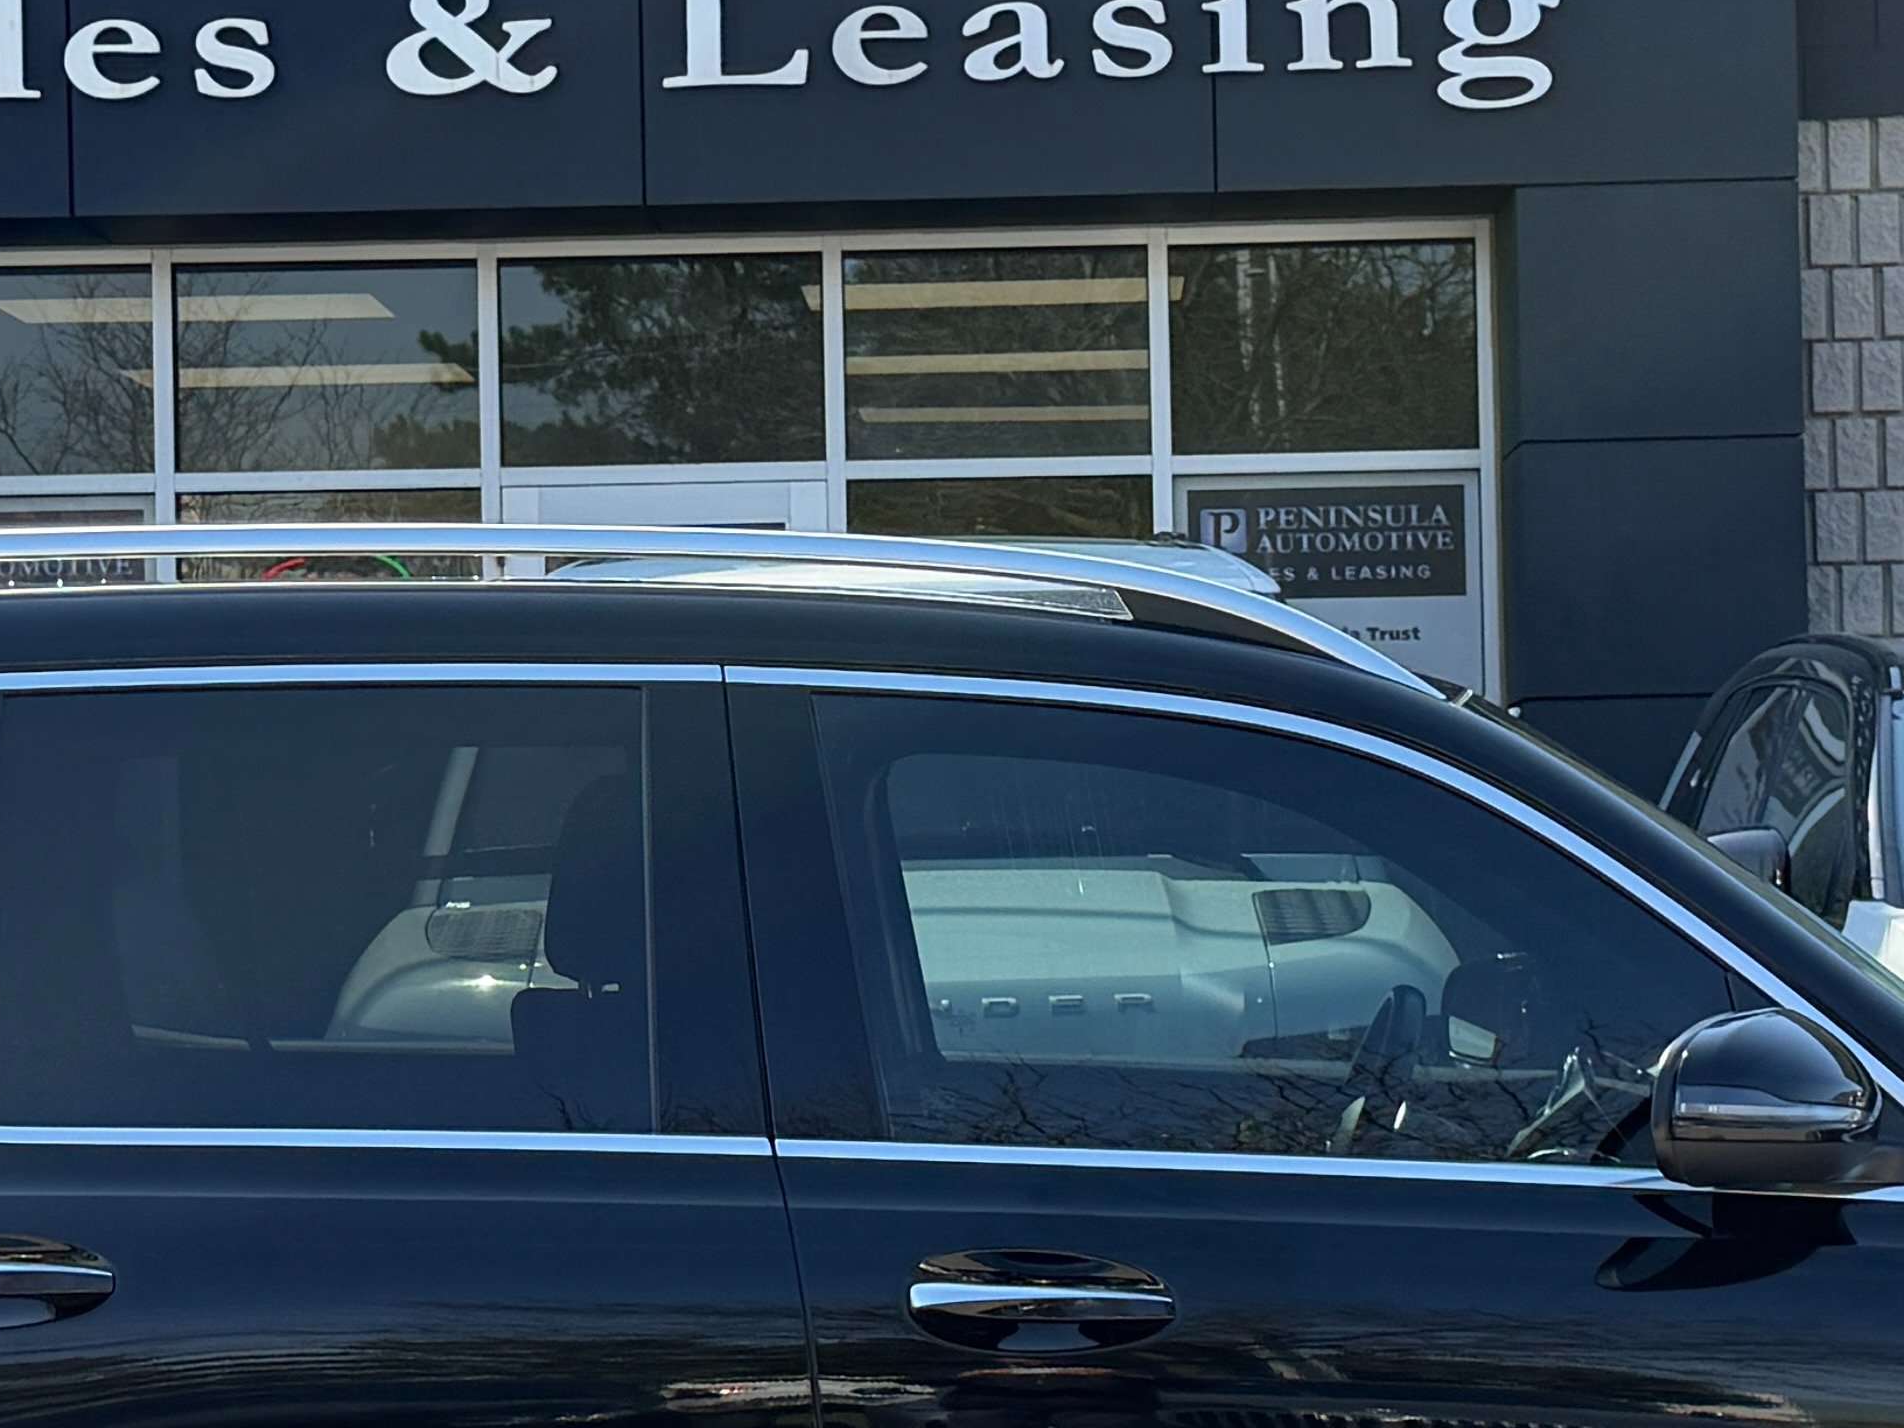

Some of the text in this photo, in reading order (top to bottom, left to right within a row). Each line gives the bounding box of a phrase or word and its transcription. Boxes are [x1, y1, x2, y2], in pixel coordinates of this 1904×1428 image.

[1256, 504, 1450, 530] PENINSULA
[1256, 530, 1456, 554] AUTOMOTIVE
[1306, 566, 1320, 581] &
[1330, 564, 1432, 581] LEASING
[1366, 627, 1422, 642] Trust
